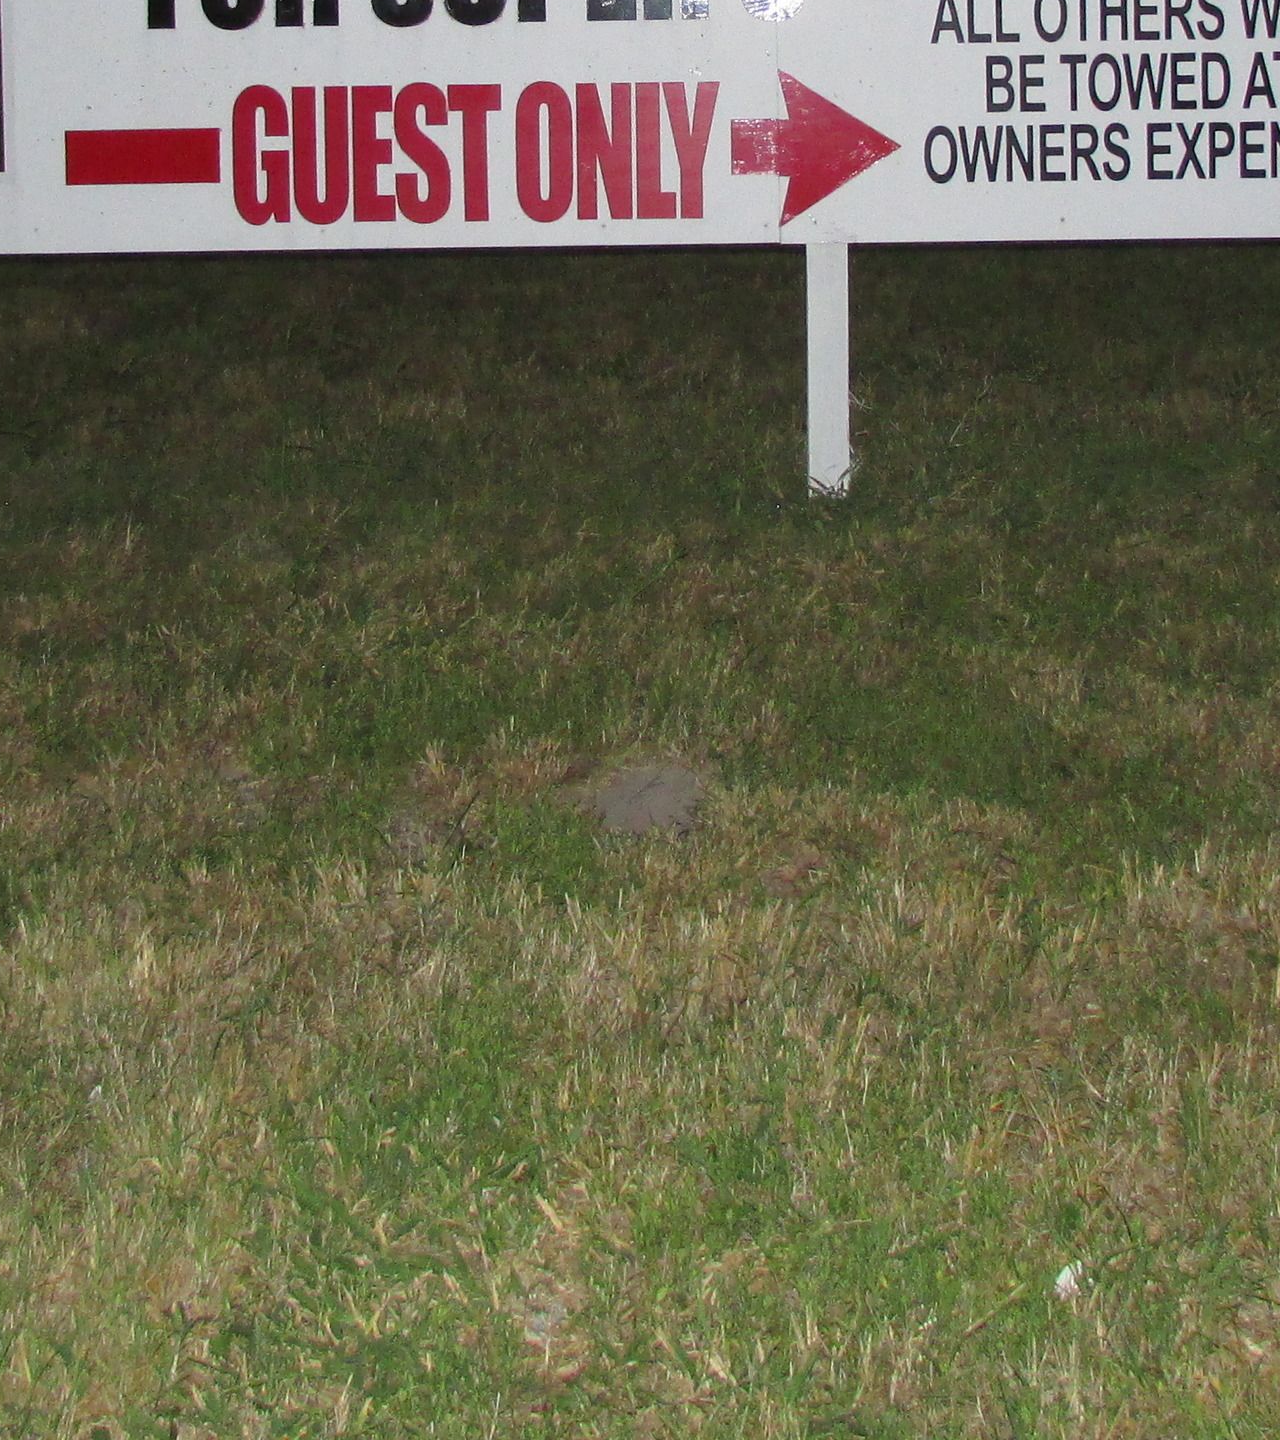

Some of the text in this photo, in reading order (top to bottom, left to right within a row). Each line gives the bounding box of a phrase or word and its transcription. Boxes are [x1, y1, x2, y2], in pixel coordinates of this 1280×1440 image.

[985, 55, 1046, 113] BE
[1060, 52, 1231, 112] TOWED
[232, 80, 720, 225] GUEST ONLY
[923, 122, 1131, 184] OWNERS
